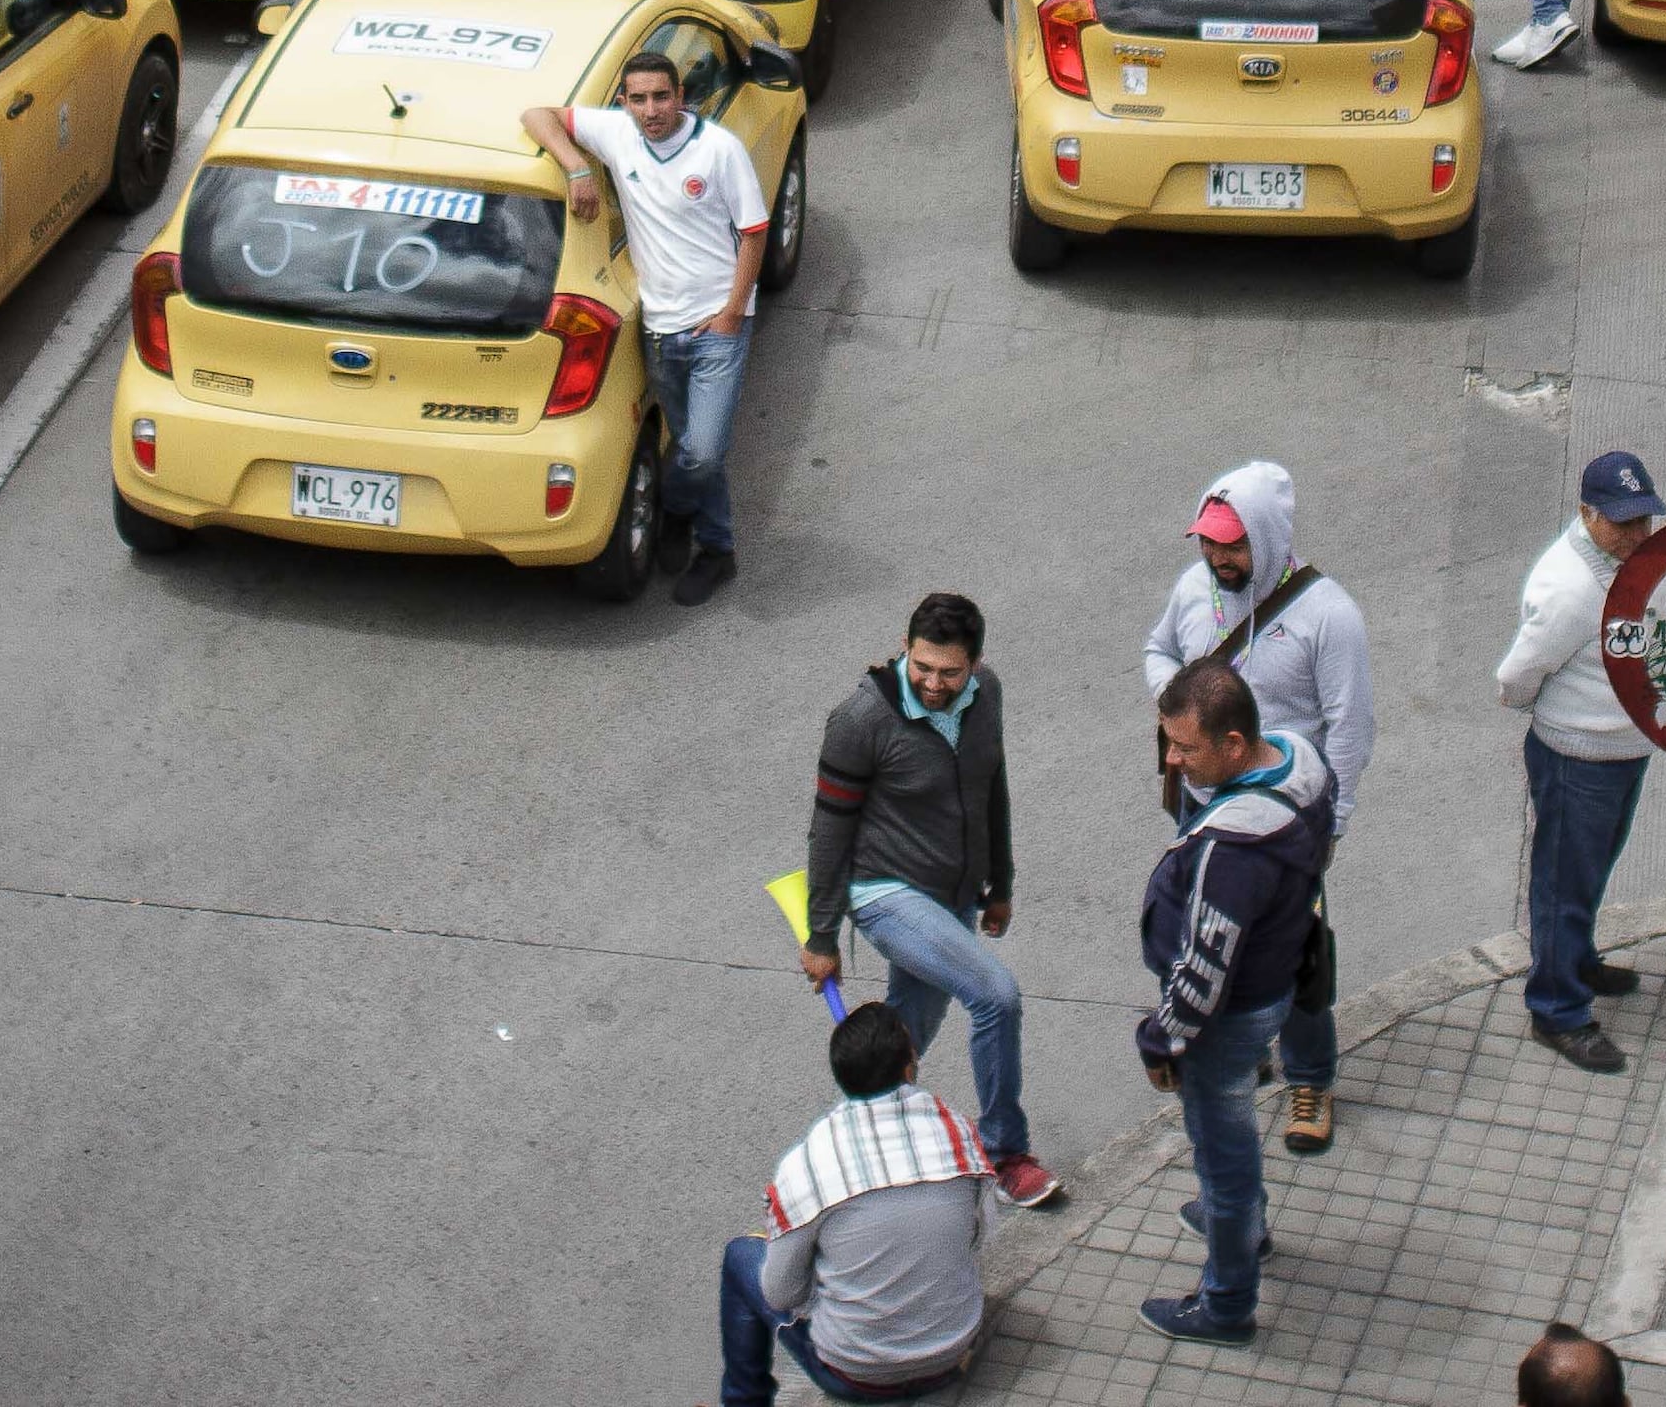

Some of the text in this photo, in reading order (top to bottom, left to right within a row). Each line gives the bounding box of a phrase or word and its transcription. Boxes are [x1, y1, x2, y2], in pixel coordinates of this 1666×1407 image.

[354, 21, 542, 52] WCL 976
[1246, 62, 1277, 76] KIA
[1212, 171, 1302, 196] WCL 583
[296, 474, 396, 512] WCL 976
